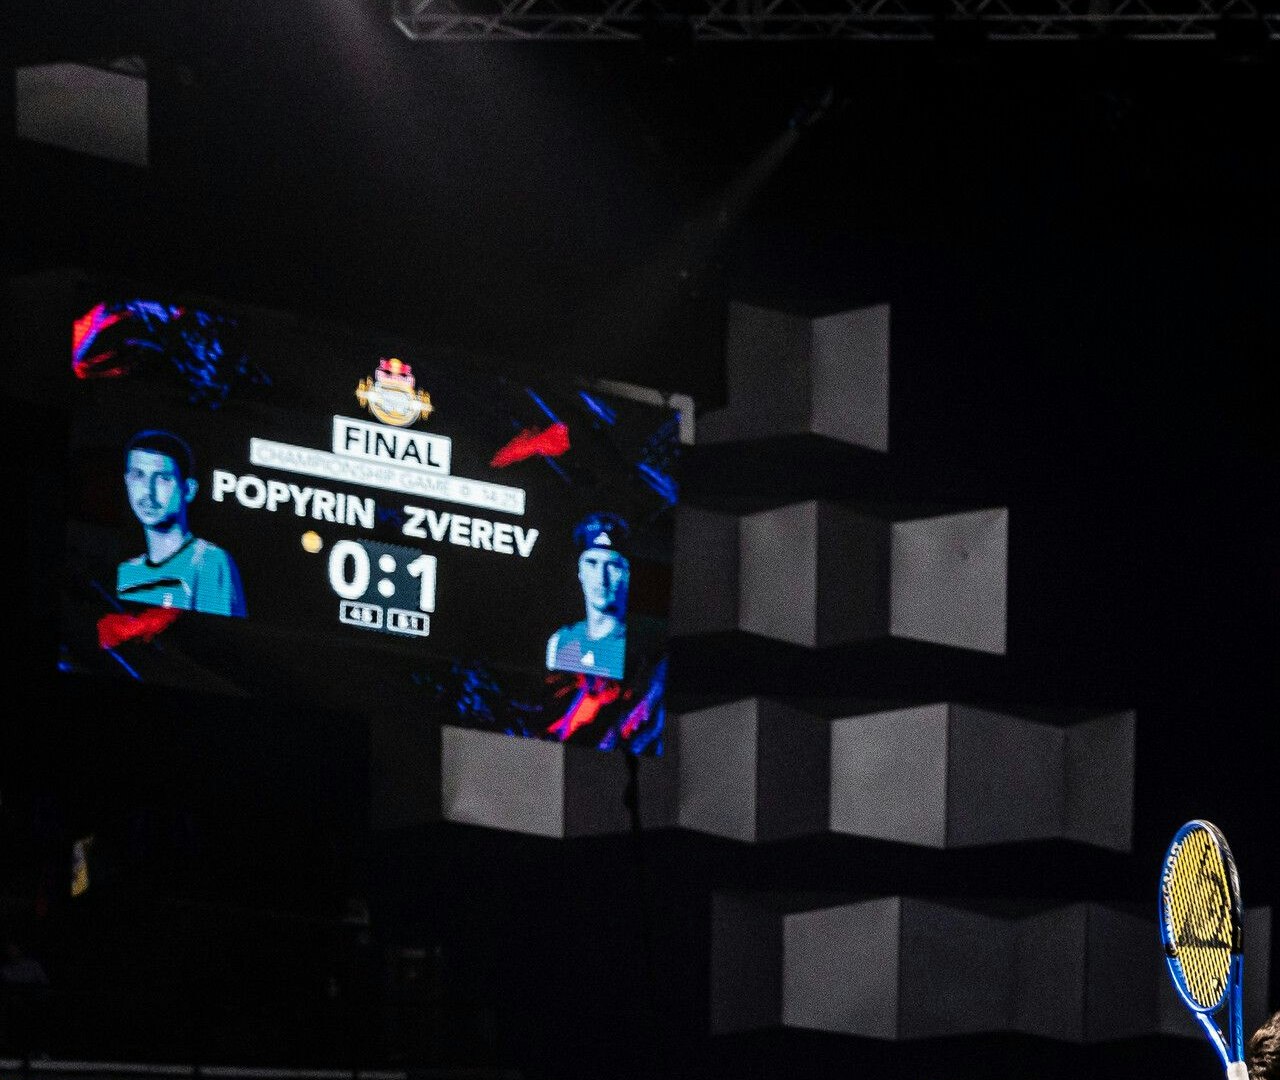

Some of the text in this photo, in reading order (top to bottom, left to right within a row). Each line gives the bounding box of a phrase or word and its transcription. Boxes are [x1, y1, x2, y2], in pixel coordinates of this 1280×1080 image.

[345, 426, 440, 468] FINAL
[211, 469, 539, 558] POPYRIN ZVEREV
[328, 539, 437, 613] 0:1
